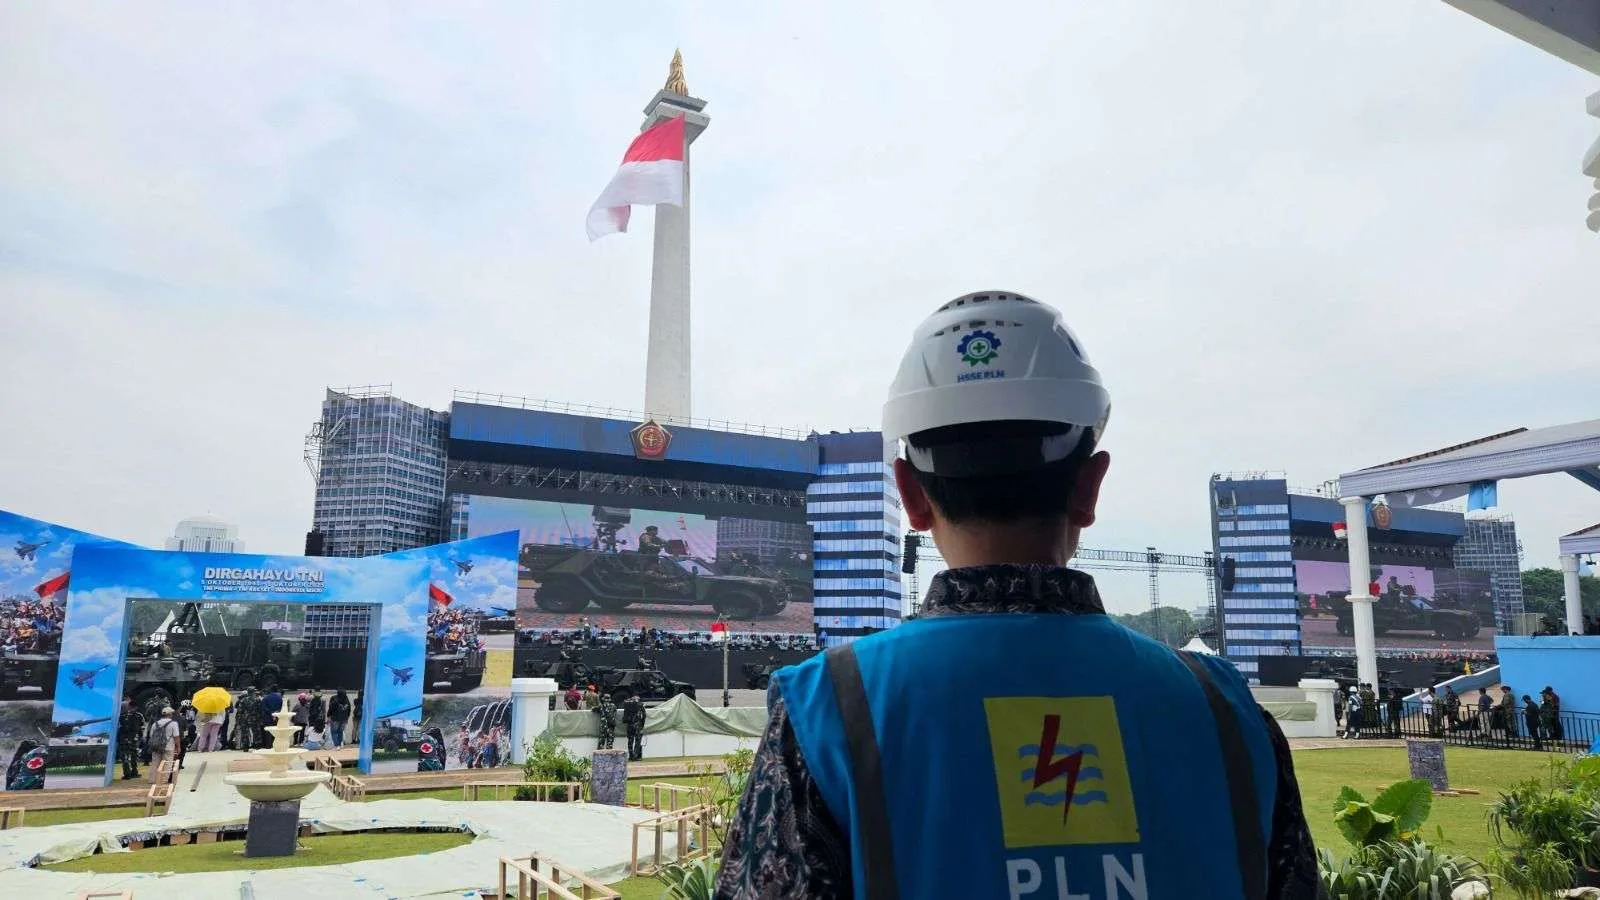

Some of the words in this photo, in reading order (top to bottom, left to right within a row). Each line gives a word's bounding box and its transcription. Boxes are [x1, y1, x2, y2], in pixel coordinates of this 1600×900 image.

[204, 567, 294, 581] DIRGAHAYU
[295, 569, 324, 582] TNI
[1006, 853, 1148, 900] PLN
